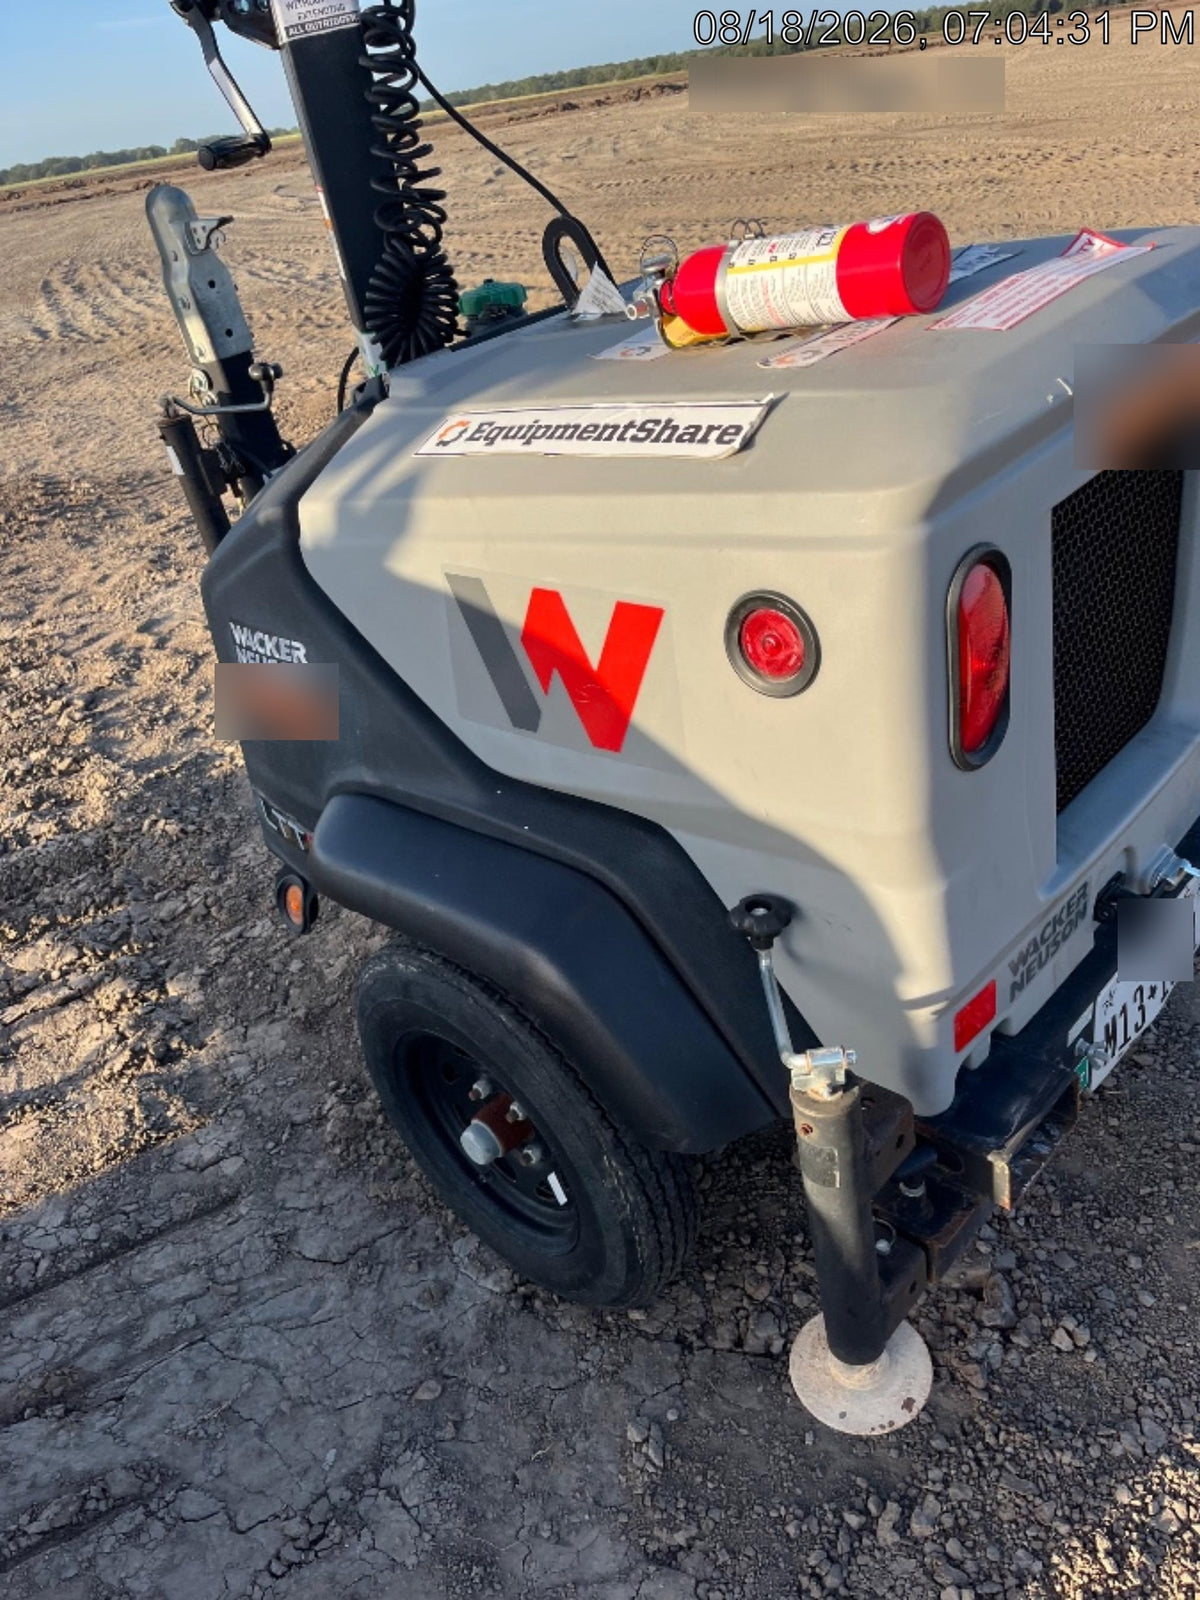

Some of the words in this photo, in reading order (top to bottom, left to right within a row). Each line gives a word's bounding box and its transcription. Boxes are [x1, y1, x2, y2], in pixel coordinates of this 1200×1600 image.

[289, 25, 304, 36] ALL
[466, 418, 744, 447] EquipmentShare
[228, 622, 308, 664] WACKER
[1008, 881, 1088, 977] WACKER
[1009, 900, 1088, 1003] NEUSON
